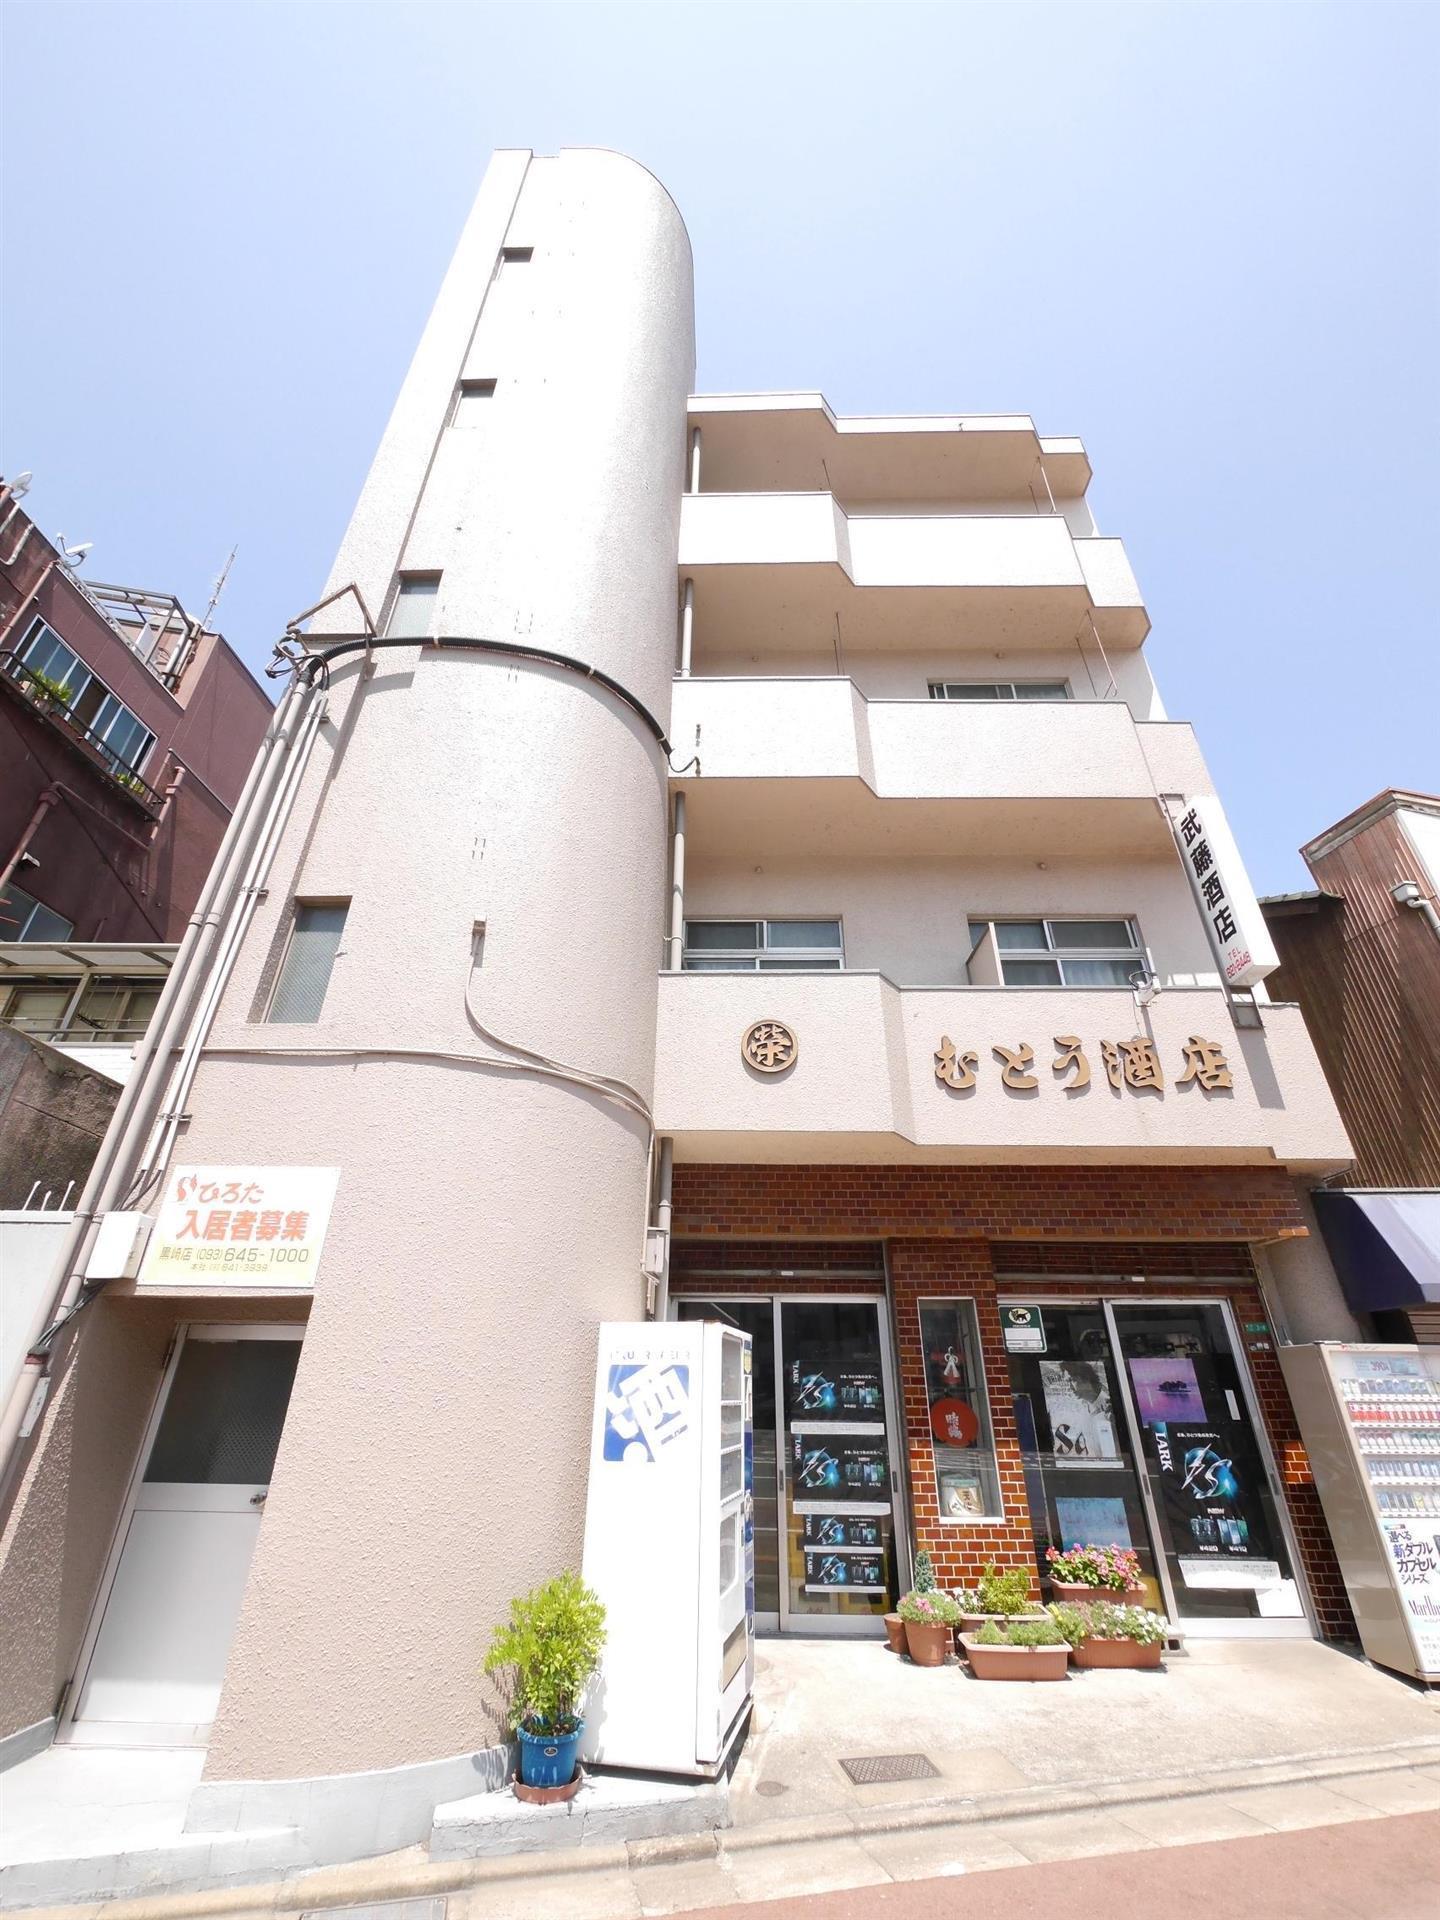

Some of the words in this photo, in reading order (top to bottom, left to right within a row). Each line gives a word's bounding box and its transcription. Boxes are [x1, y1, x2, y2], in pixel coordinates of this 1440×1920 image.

[1181, 808, 1237, 944] 武藤酒店
[1227, 947, 1241, 959] TEL
[935, 1035, 1234, 1092] むとう酒店
[198, 1182, 264, 1204] ひろた
[176, 1210, 310, 1241] 入居者募集
[1154, 1432, 1174, 1472] LARK
[1393, 1542, 1433, 1559] 新ダブル
[1397, 1558, 1437, 1573] カプセル
[1401, 1573, 1430, 1585] シリーズ
